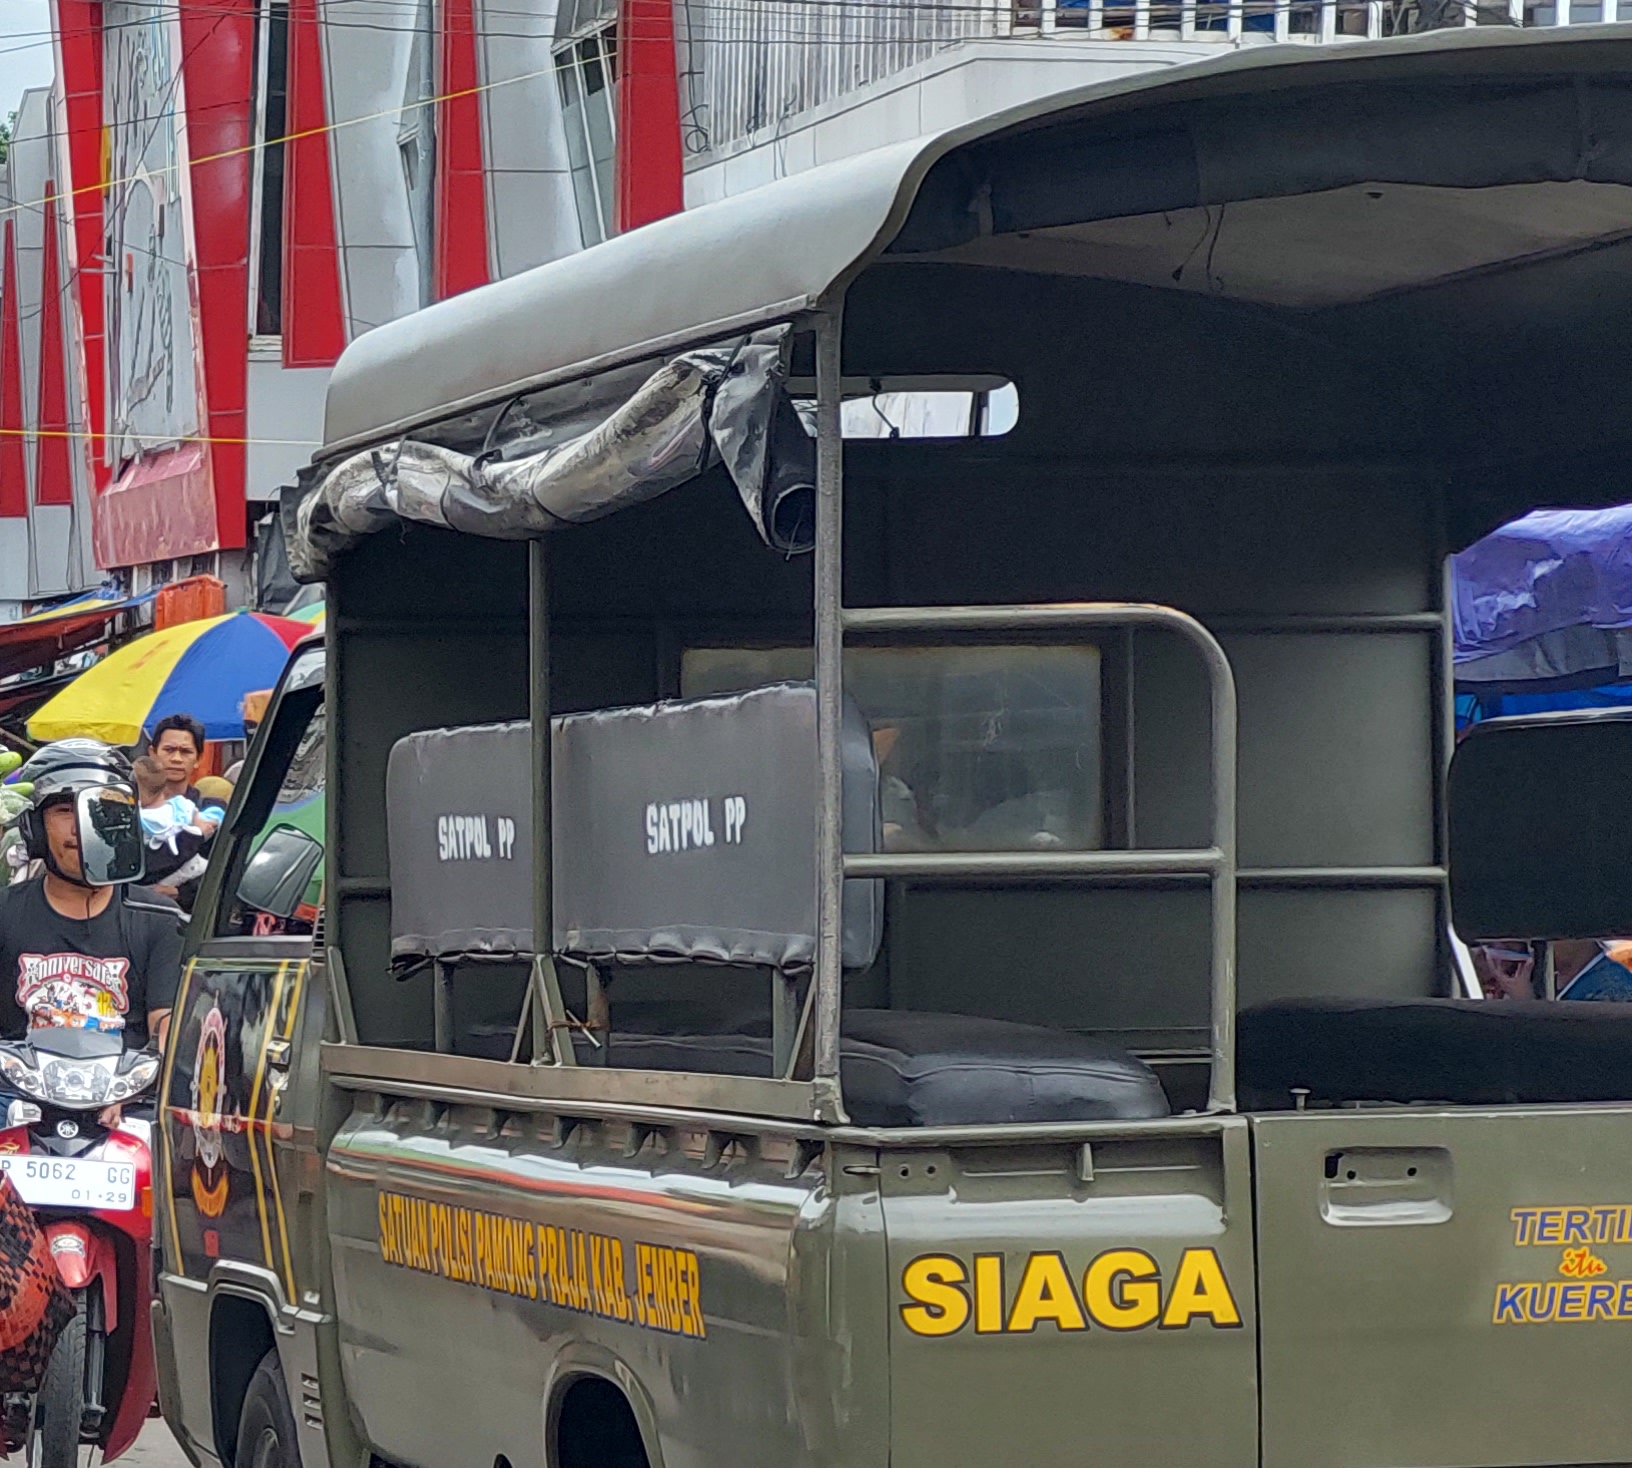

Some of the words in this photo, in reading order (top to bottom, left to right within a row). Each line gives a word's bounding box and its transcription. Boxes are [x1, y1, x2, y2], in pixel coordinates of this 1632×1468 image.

[438, 814, 492, 861] SATPOL
[497, 816, 515, 860] PP
[646, 798, 715, 854] SATPOL
[724, 796, 746, 845] PP
[26, 1161, 76, 1180] 5062
[107, 1167, 130, 1184] GG
[1510, 1205, 1632, 1246] TERTI
[378, 1189, 431, 1273] SATUAN
[429, 1202, 477, 1286] POLISI
[474, 1209, 537, 1300] PAMONG
[537, 1222, 594, 1316] PRAJA
[589, 1232, 634, 1326] KAB.
[633, 1240, 707, 1340] JEMBER
[1559, 1246, 1607, 1278] itu
[899, 1247, 1244, 1338] SIAGA
